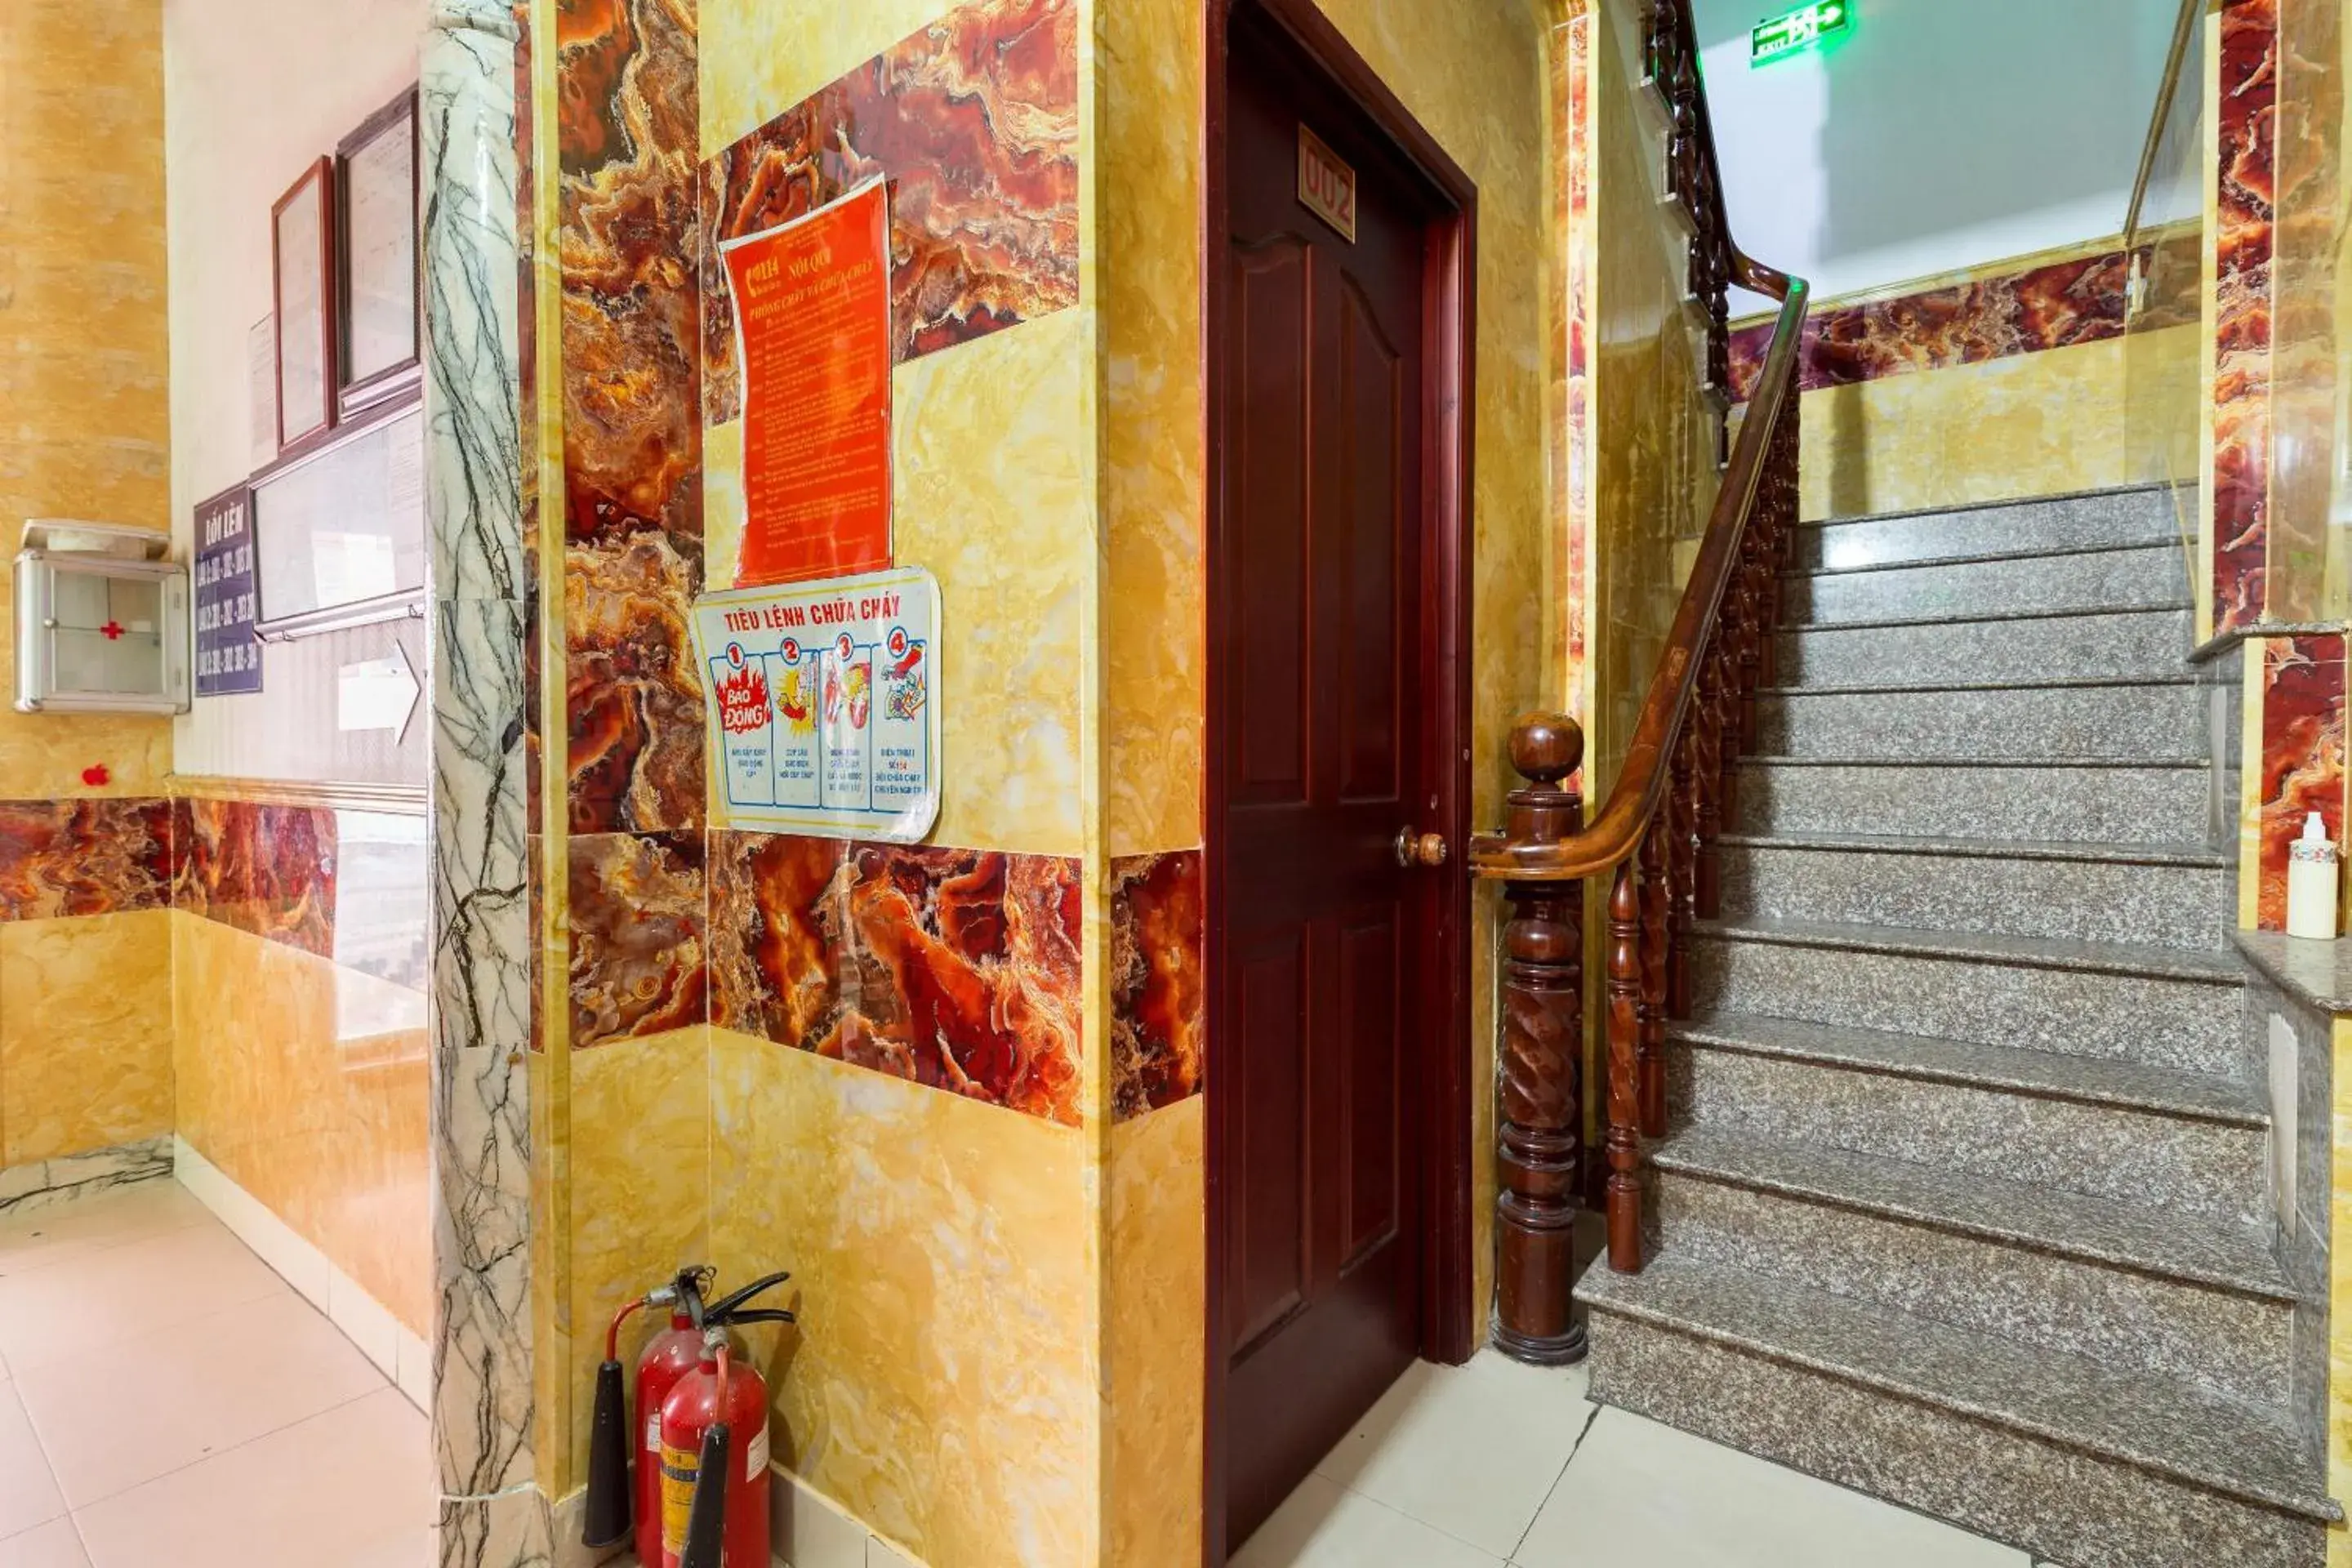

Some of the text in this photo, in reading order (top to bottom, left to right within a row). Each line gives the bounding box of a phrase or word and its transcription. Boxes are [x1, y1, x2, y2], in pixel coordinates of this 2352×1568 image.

[724, 590, 900, 632] TIÊU LỆNH CHỮA CHÁY
[784, 640, 797, 659] 2
[839, 636, 850, 657] 3
[890, 632, 904, 652] 4
[729, 646, 740, 663] 1
[727, 686, 751, 706] BÁO
[724, 705, 763, 730] ĐỘNG
